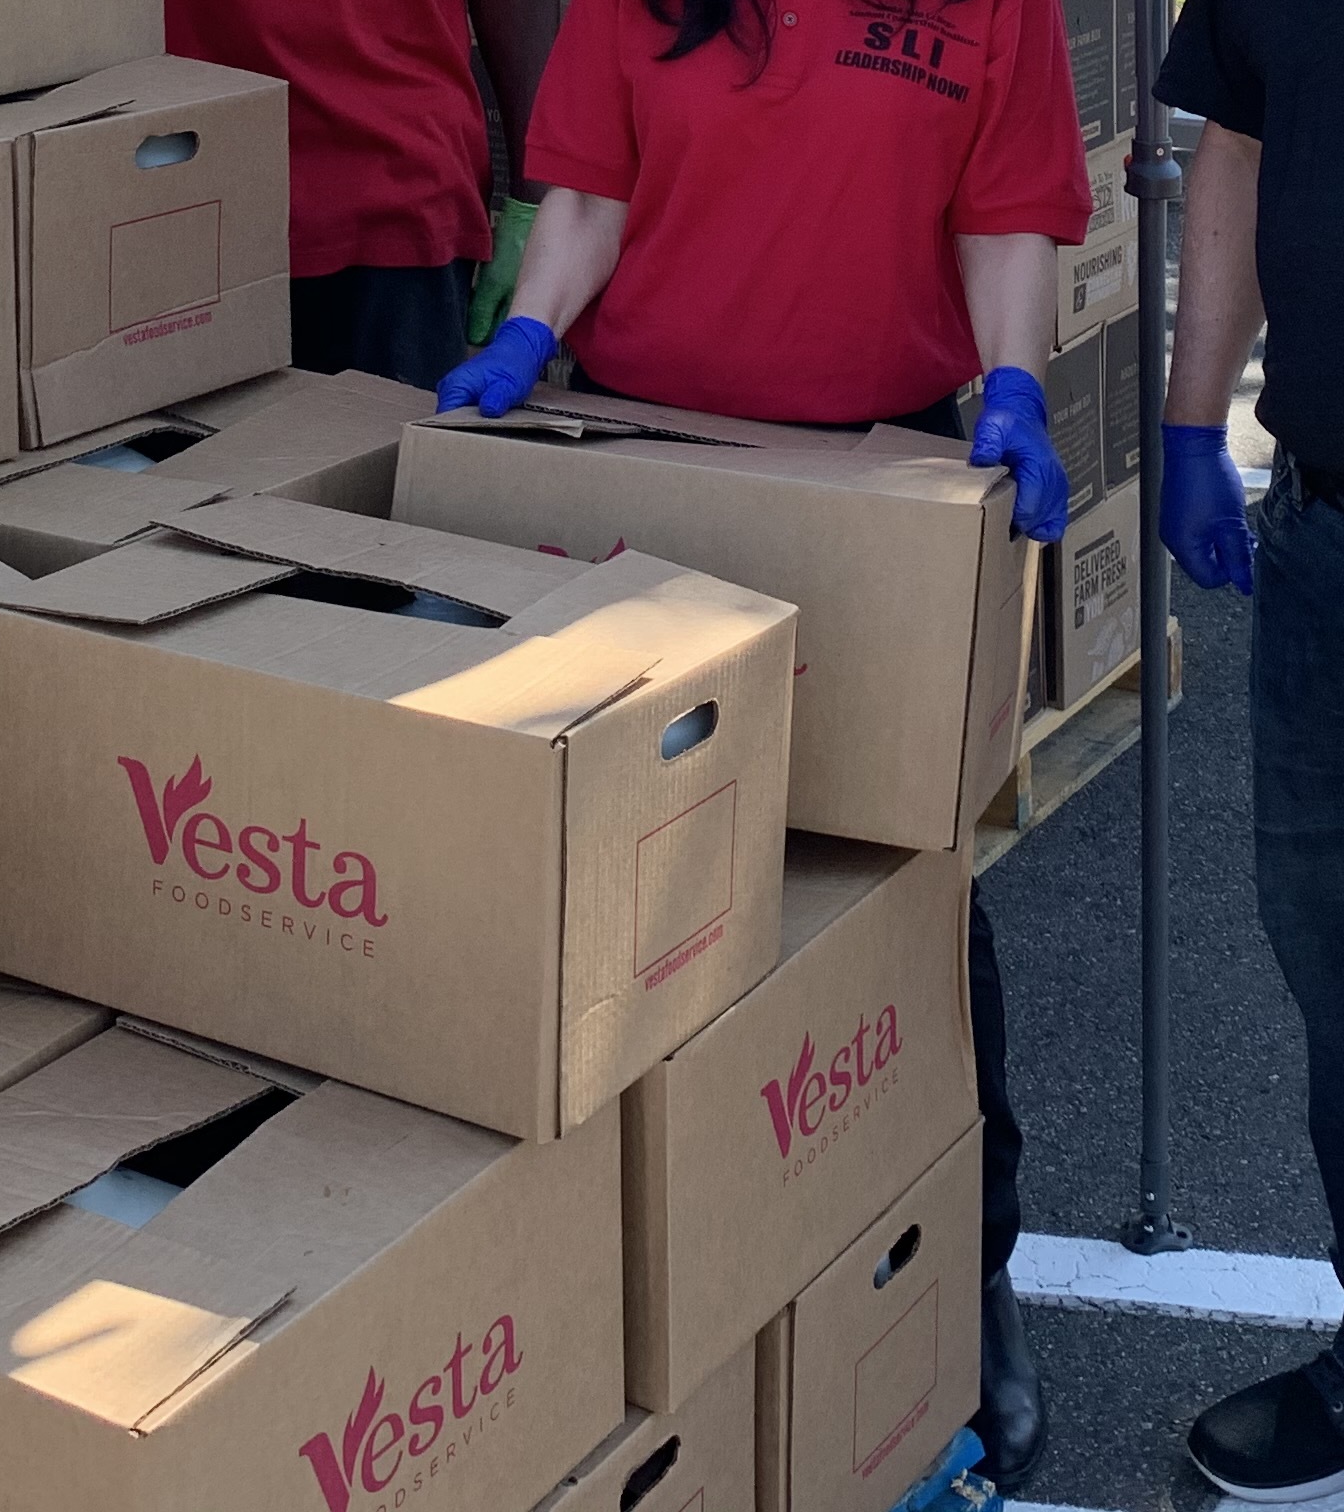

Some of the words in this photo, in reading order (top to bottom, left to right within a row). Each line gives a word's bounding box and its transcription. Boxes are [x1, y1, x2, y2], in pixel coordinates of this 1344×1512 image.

[835, 49, 927, 85] LEADERSHIP
[927, 72, 970, 104] NOW!
[1073, 245, 1123, 285] NOURISHING
[122, 311, 213, 347] vestafoodservice.com
[1075, 539, 1121, 585] DELIVERED
[1075, 574, 1099, 607] FARM
[1102, 556, 1127, 591] FRESH
[117, 753, 389, 928] Vesta
[152, 879, 375, 959] FOODSERVICE
[760, 1004, 904, 1160] Vesta
[782, 1067, 899, 1187] FOODSERVICE
[299, 1314, 524, 1512] Vesta
